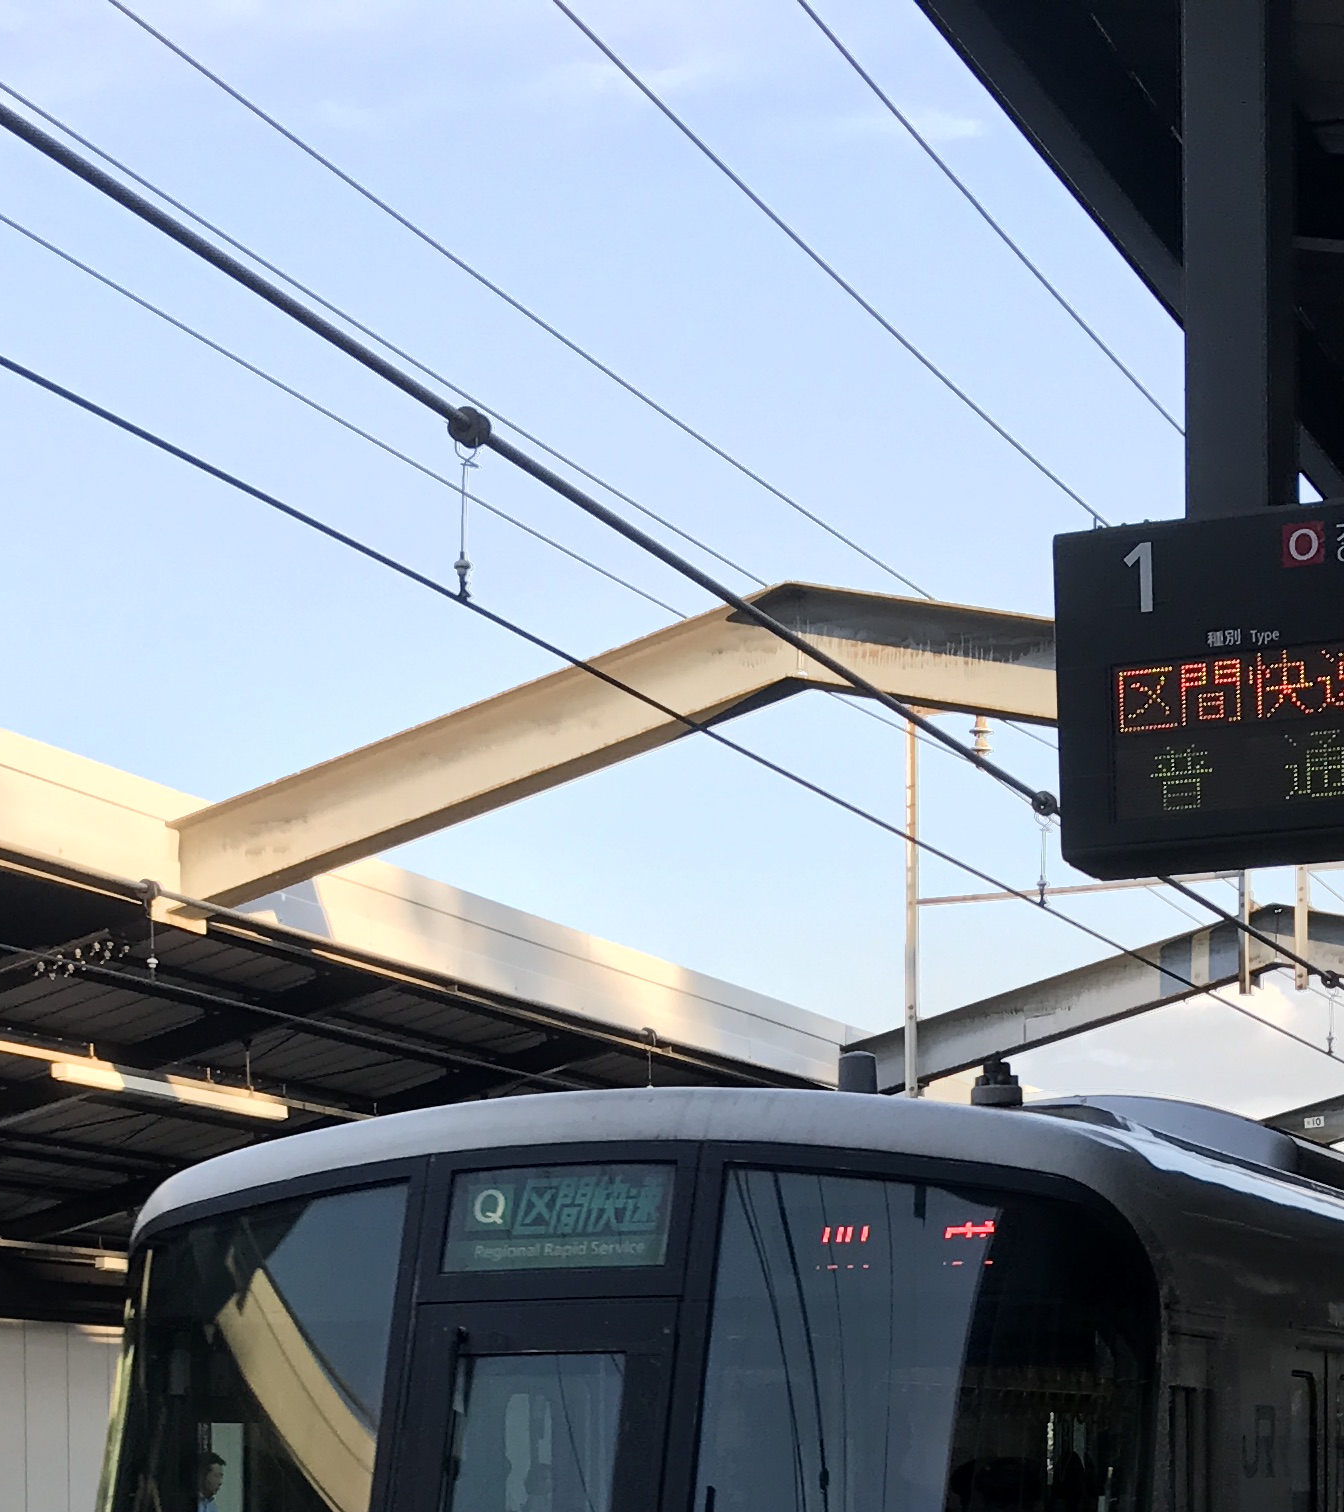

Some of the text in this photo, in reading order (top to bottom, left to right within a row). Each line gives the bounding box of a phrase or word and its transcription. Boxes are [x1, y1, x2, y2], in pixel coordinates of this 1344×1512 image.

[1288, 528, 1318, 561] O
[1123, 540, 1154, 613] 1
[1207, 627, 1280, 648] 種別 Type
[473, 1188, 507, 1225] Q
[474, 1240, 646, 1261] Regional Rapid Service
